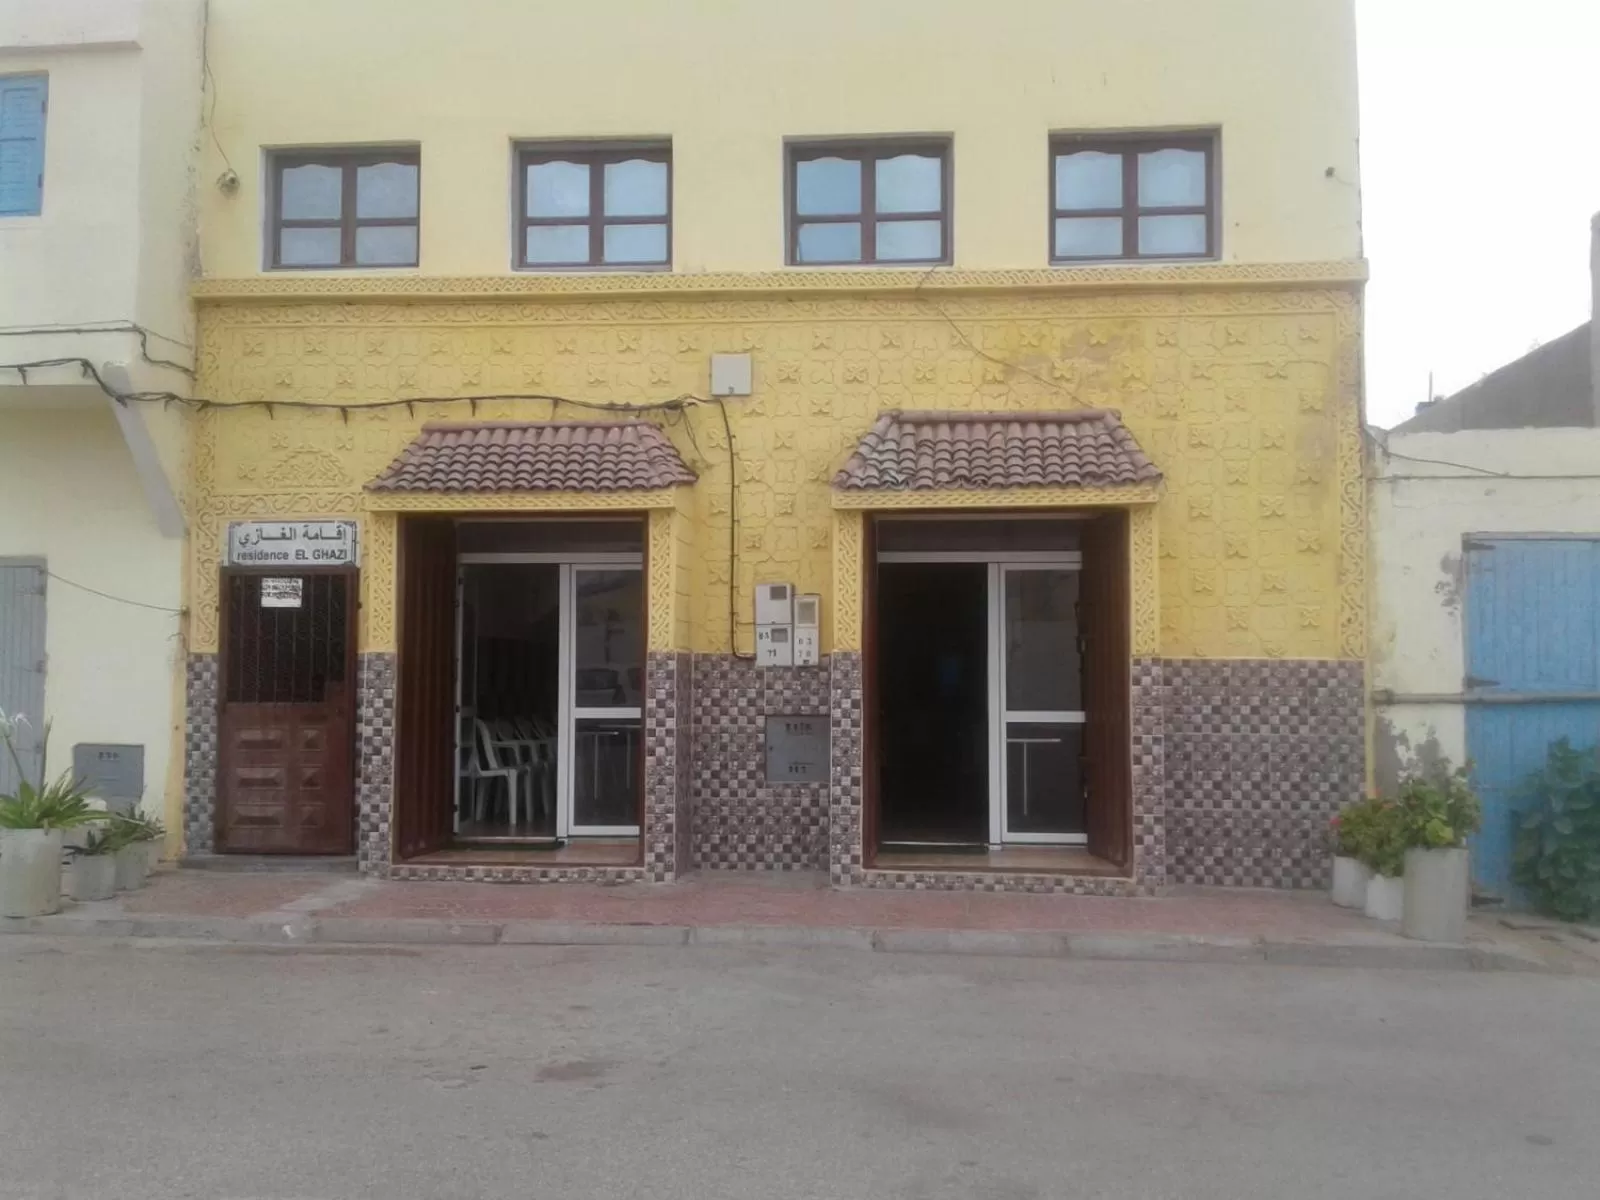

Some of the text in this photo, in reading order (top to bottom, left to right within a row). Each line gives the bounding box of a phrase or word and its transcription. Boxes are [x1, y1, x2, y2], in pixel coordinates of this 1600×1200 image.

[238, 524, 346, 548] إقامة الغازي
[237, 549, 347, 560] residence EL GHAZI
